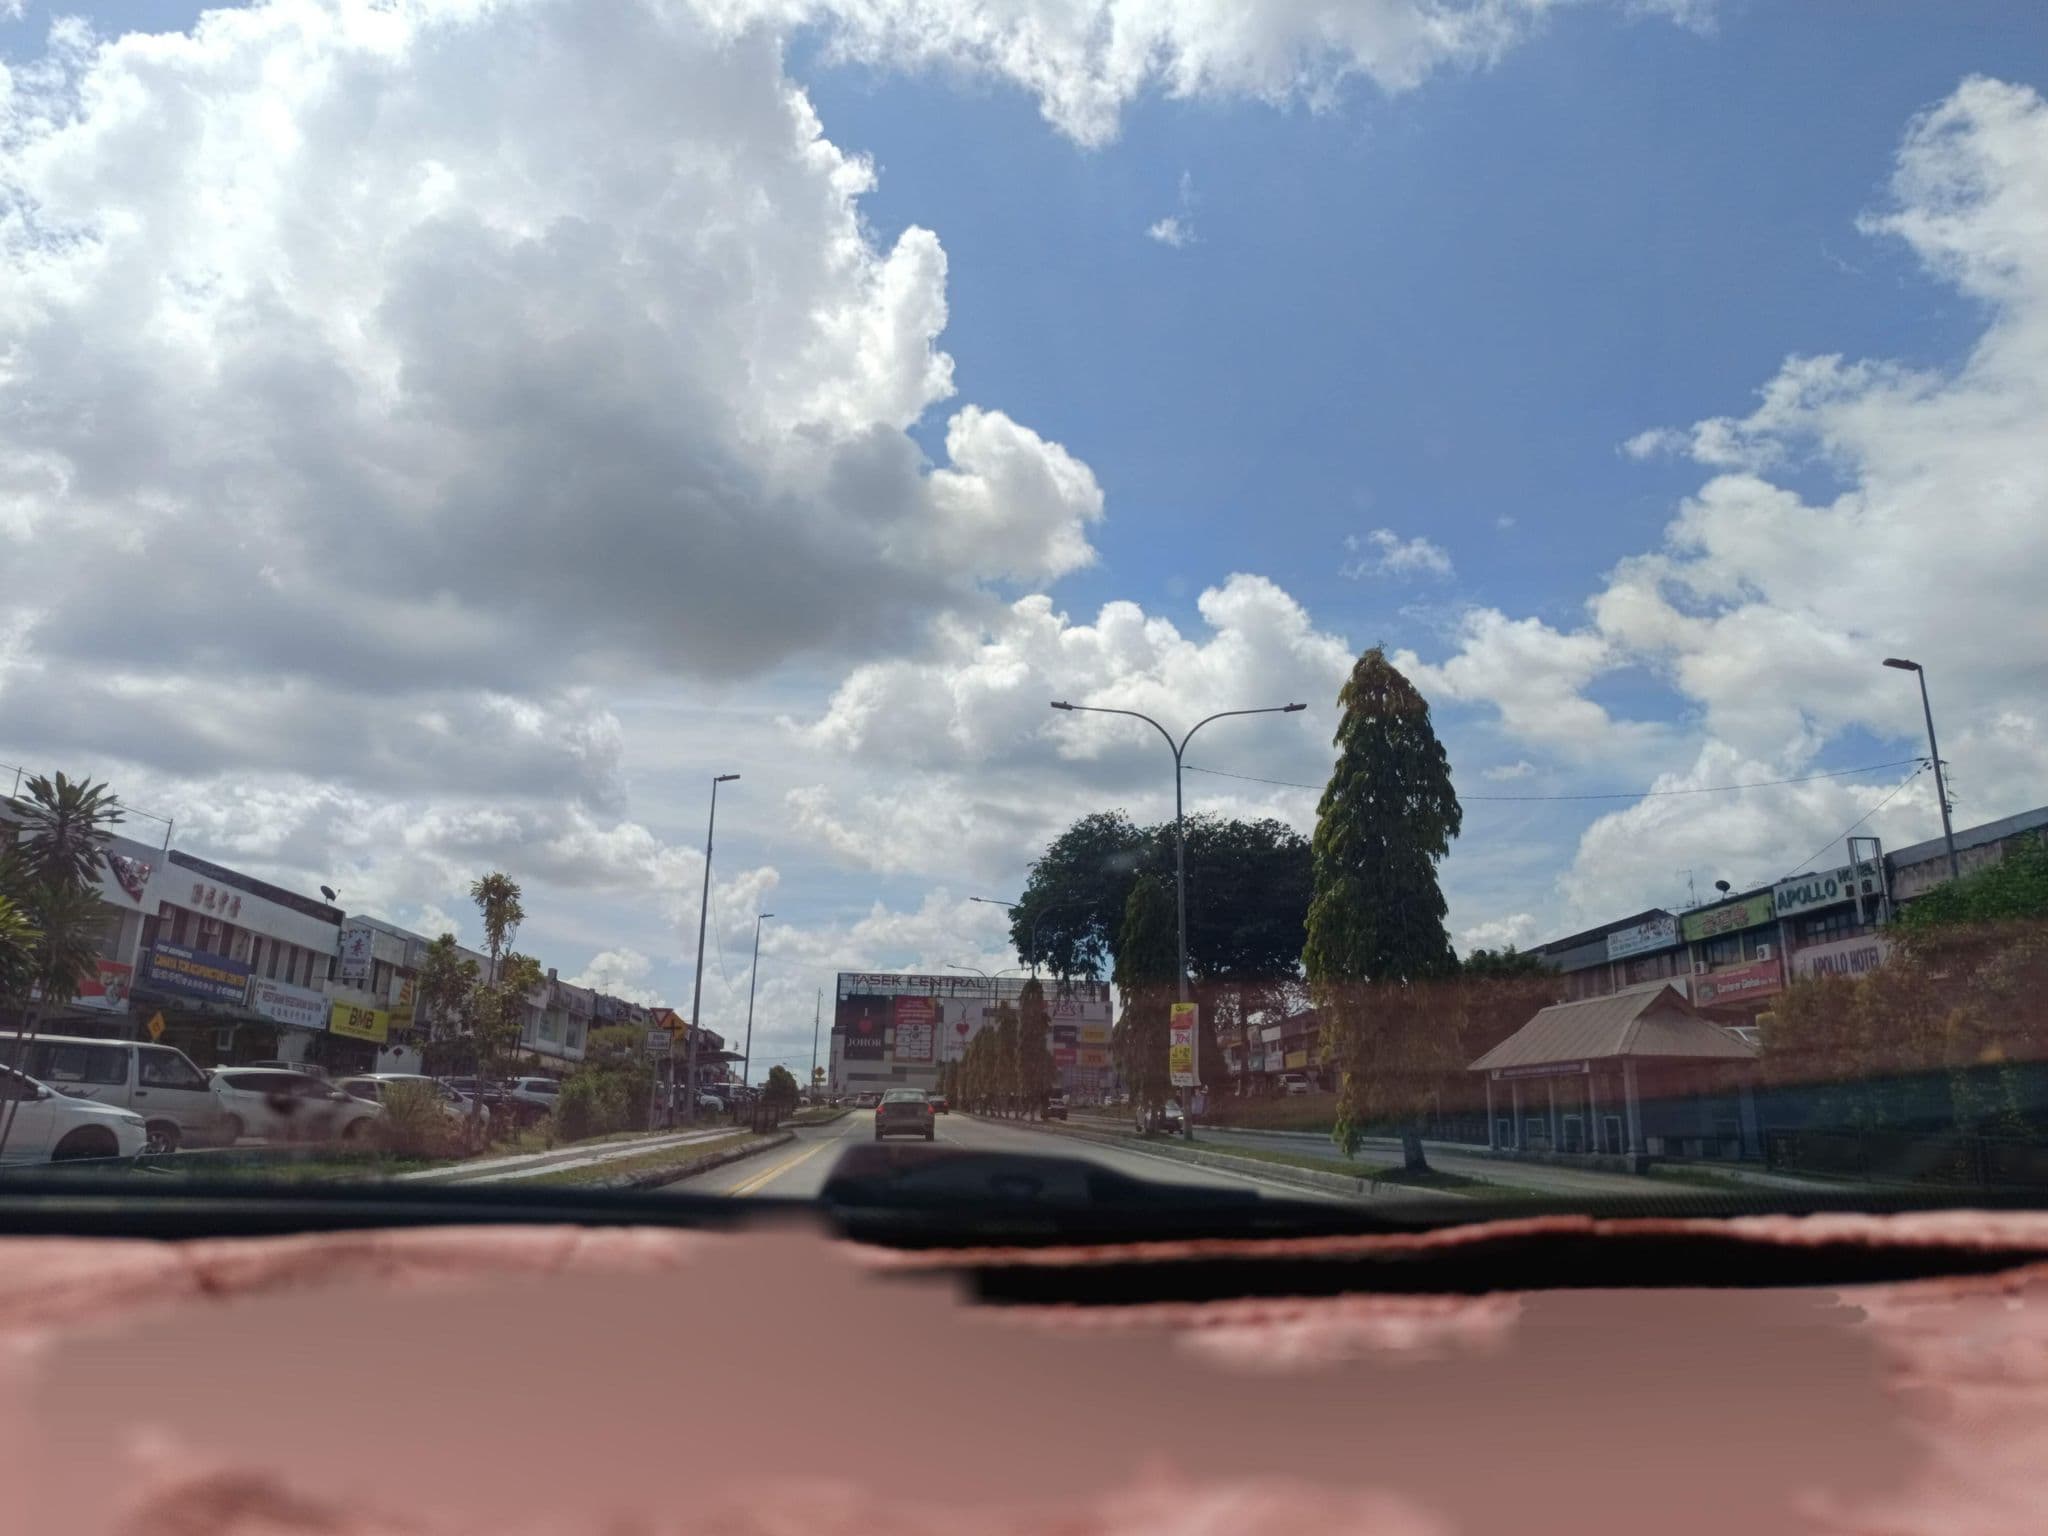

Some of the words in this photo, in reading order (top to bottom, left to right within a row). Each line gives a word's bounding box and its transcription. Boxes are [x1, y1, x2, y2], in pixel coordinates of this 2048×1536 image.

[1777, 878, 1837, 910] APOLLO
[1812, 952, 1848, 978] APOLLO
[1849, 946, 1880, 974] HOTEL
[852, 975, 902, 986] TASEK
[908, 975, 986, 988] CENTRAL
[349, 1007, 374, 1030] BMB
[846, 1038, 882, 1048] JOHOR
